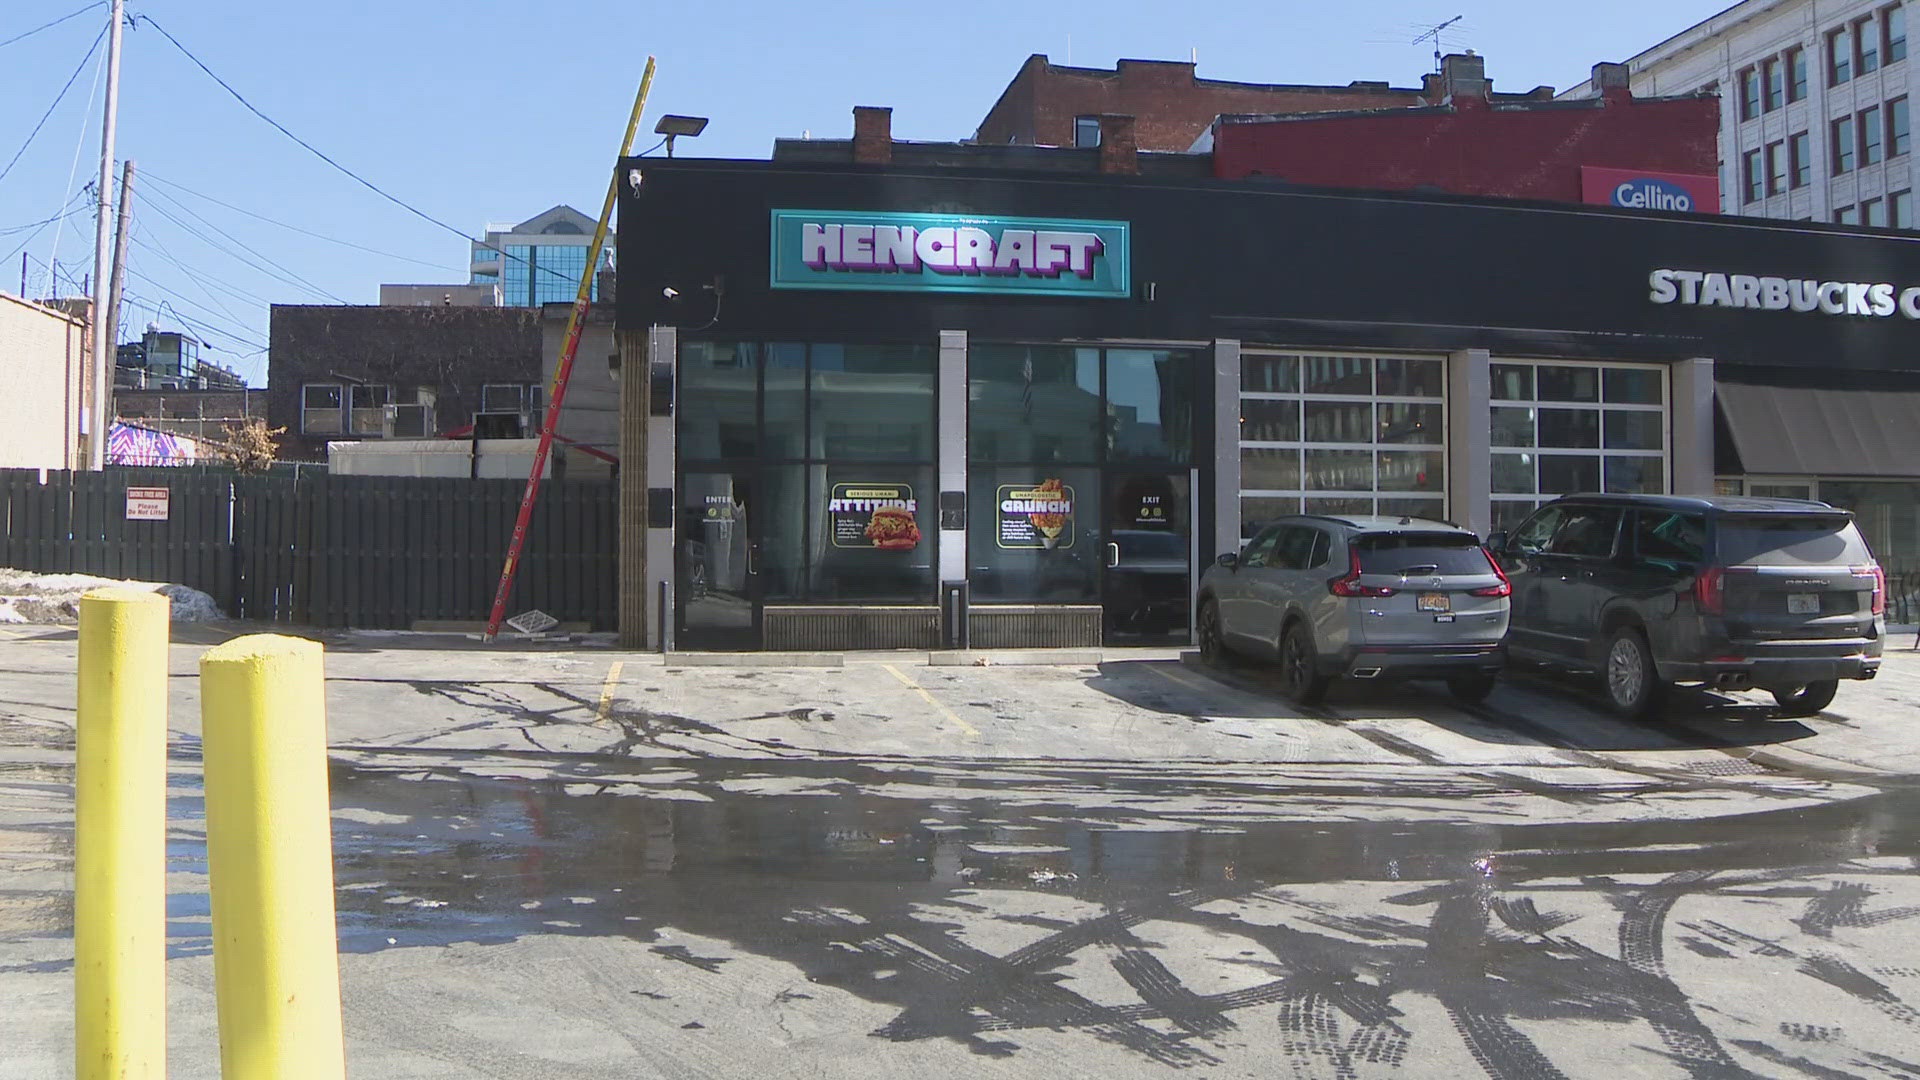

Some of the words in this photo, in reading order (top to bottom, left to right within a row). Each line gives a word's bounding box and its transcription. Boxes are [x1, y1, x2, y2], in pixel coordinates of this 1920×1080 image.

[1616, 184, 1690, 212] Cellino
[802, 223, 1105, 278] HENCRAFT
[1649, 269, 1896, 317] STARBUCKS
[828, 498, 917, 513] ATTITUDE
[1001, 500, 1071, 513] CRUNCH
[1142, 496, 1160, 504] EXIT
